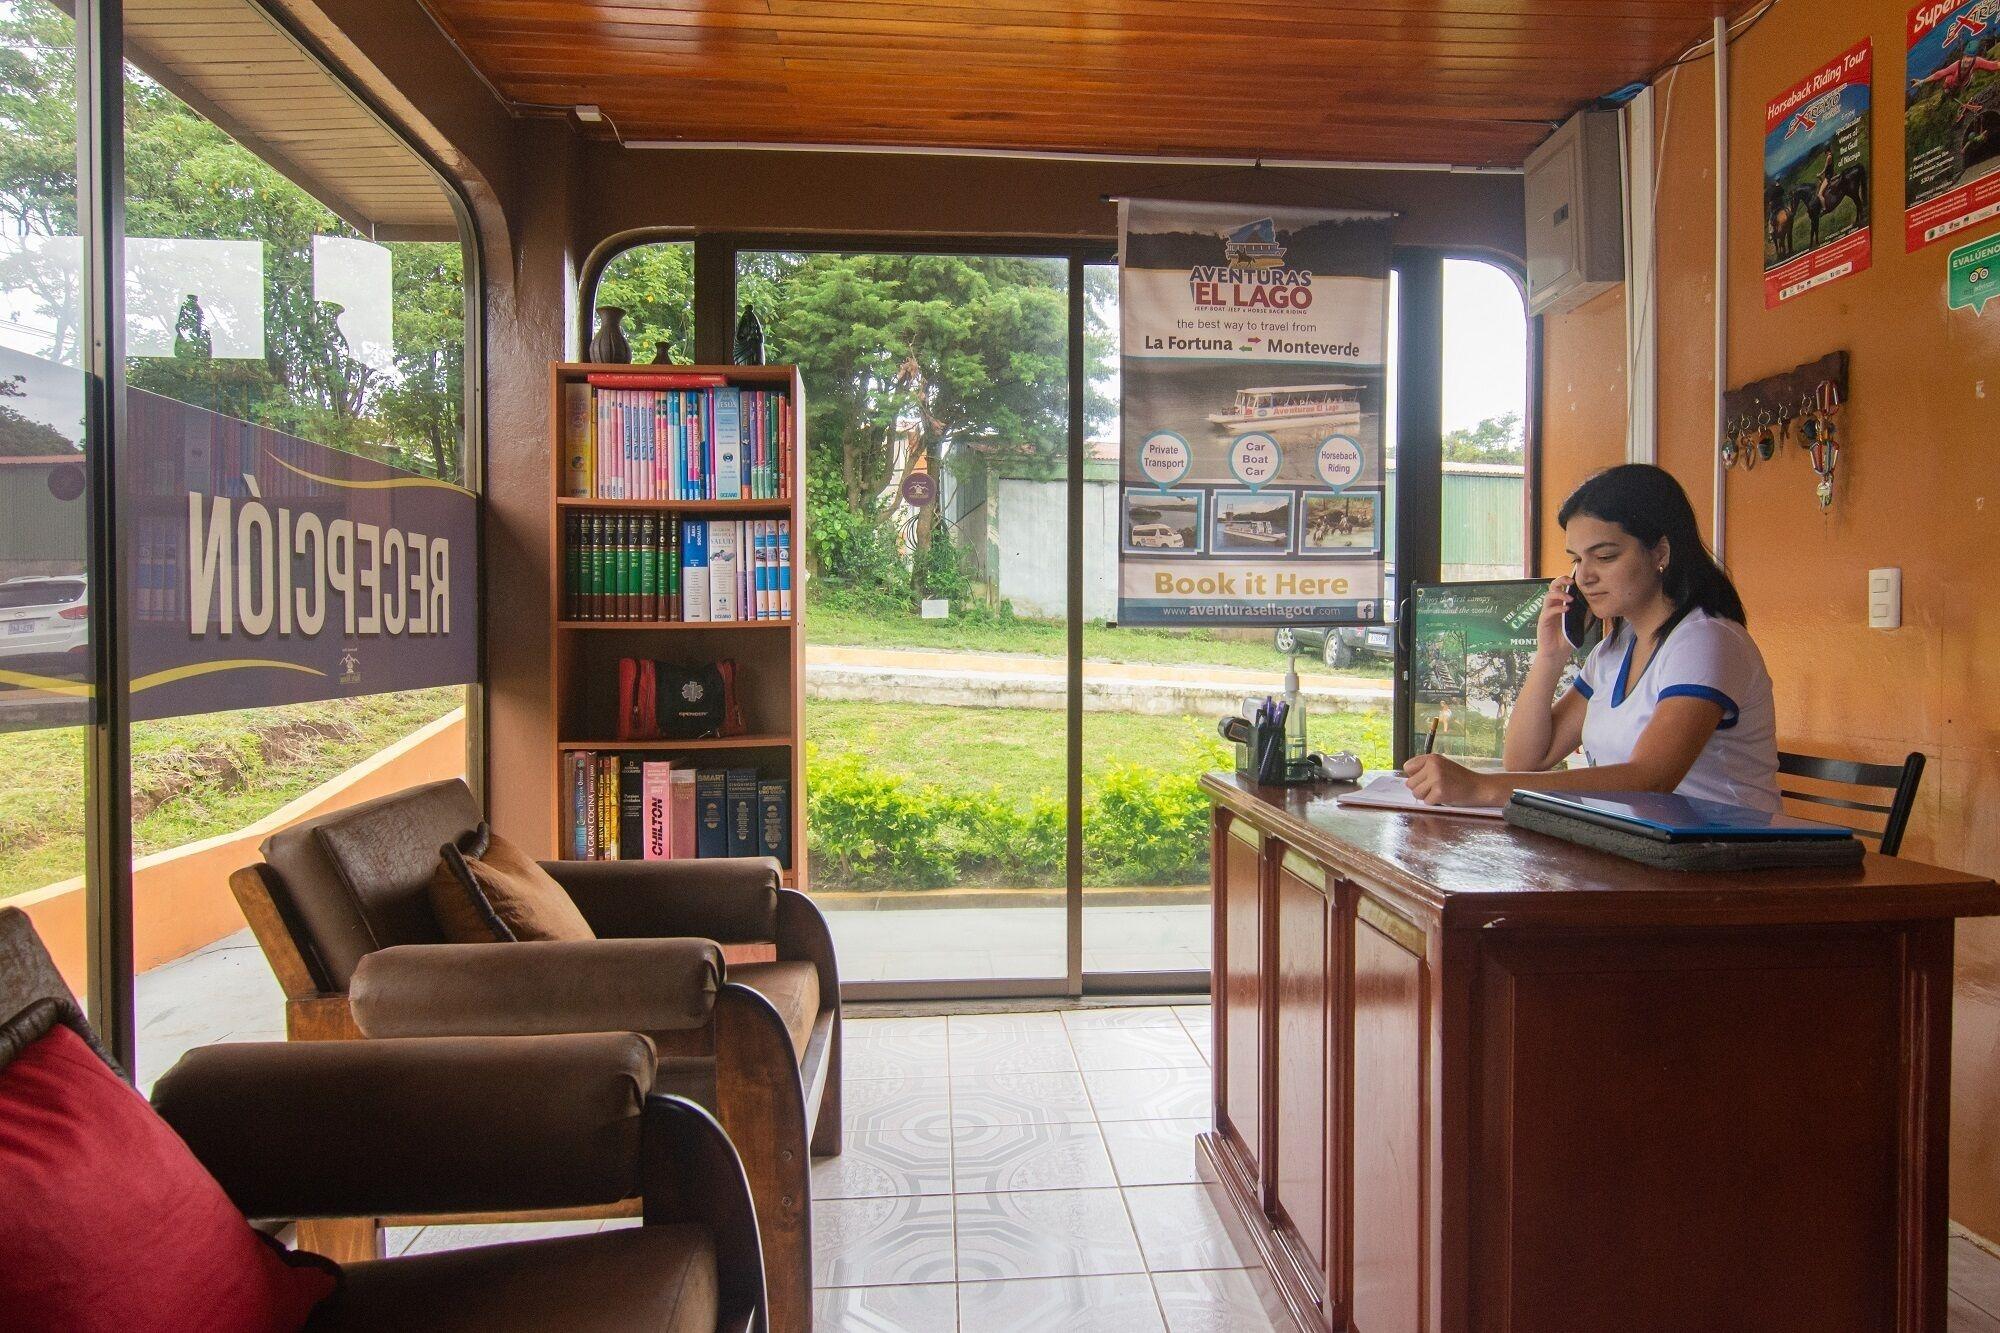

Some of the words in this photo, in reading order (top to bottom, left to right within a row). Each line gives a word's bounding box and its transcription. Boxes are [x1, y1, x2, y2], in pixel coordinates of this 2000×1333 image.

[1914, 0, 1965, 34] Super
[1768, 82, 1812, 120] Horseback
[1813, 65, 1842, 92] Riding
[1844, 49, 1867, 72] Tour
[1190, 266, 1312, 286] AVENTURAS
[1196, 282, 1226, 306] EL
[1234, 284, 1312, 310] LAGO
[1177, 319, 1194, 329] the
[1198, 320, 1220, 329] best
[1224, 322, 1244, 332] way
[1247, 322, 1257, 330] to
[1261, 321, 1289, 332] travel
[1292, 322, 1317, 332] from
[1145, 336, 1163, 350] La
[1168, 336, 1233, 351] Fortuna
[1267, 339, 1360, 357] Monteverde
[1150, 444, 1178, 455] Private
[1246, 442, 1266, 452] Car
[1242, 454, 1268, 464] Boat
[1321, 450, 1358, 460] Horseback
[1144, 457, 1184, 470] Transport
[1328, 464, 1350, 474] Riding
[1246, 467, 1265, 476] Car
[1154, 572, 1236, 595] Book
[1245, 572, 1266, 595] it
[1276, 573, 1349, 595] Here
[1467, 596, 1490, 604] canopy
[1163, 603, 1341, 619] www.aventurasellagocr.com
[1459, 606, 1470, 614] the
[1471, 606, 1493, 614] world
[1502, 610, 1517, 624] THE
[652, 797, 662, 856] CHILTON
[588, 848, 594, 856] LA
